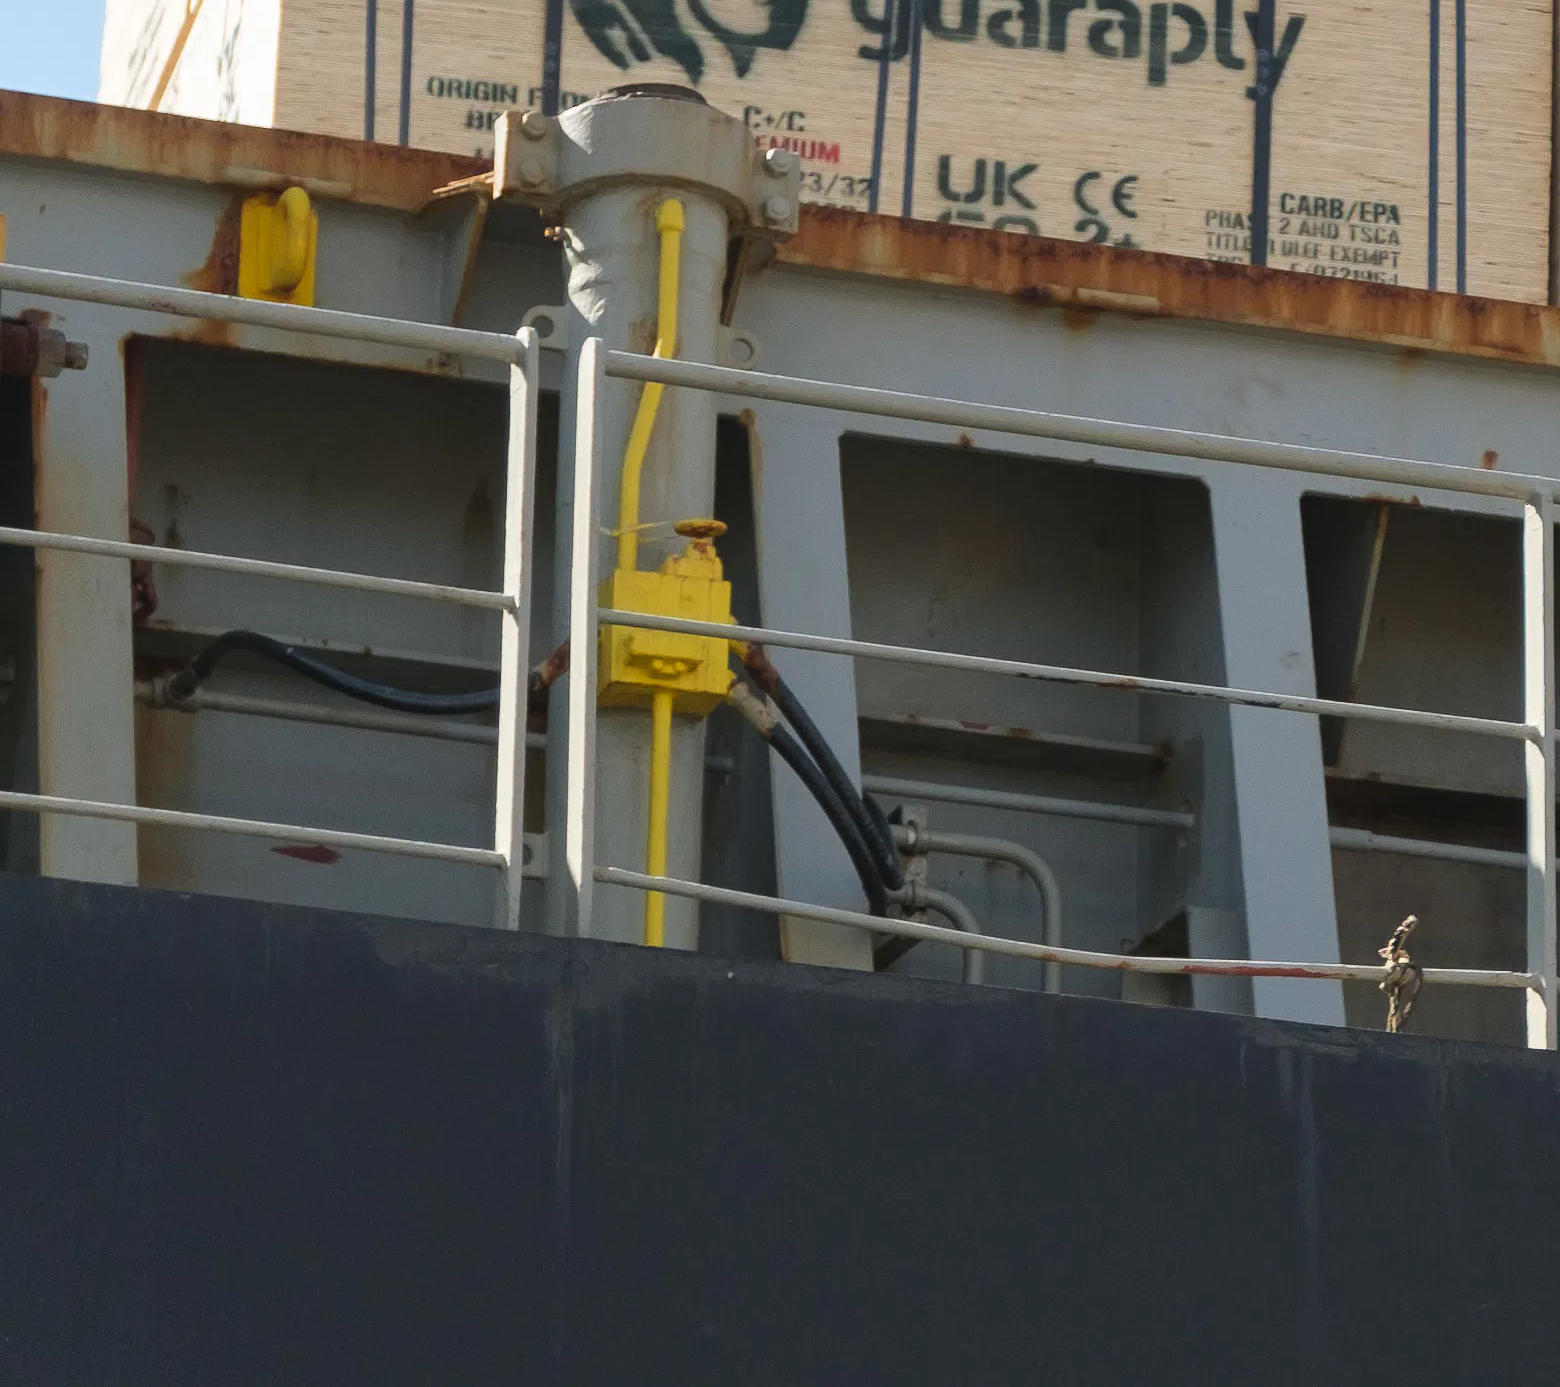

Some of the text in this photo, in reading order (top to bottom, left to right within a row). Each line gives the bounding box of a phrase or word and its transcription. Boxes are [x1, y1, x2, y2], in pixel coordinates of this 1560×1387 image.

[426, 76, 516, 104] ORIGIN
[937, 154, 1039, 209] UK
[1280, 192, 1400, 225] CARB/EPA
[1348, 224, 1400, 245] TSCA
